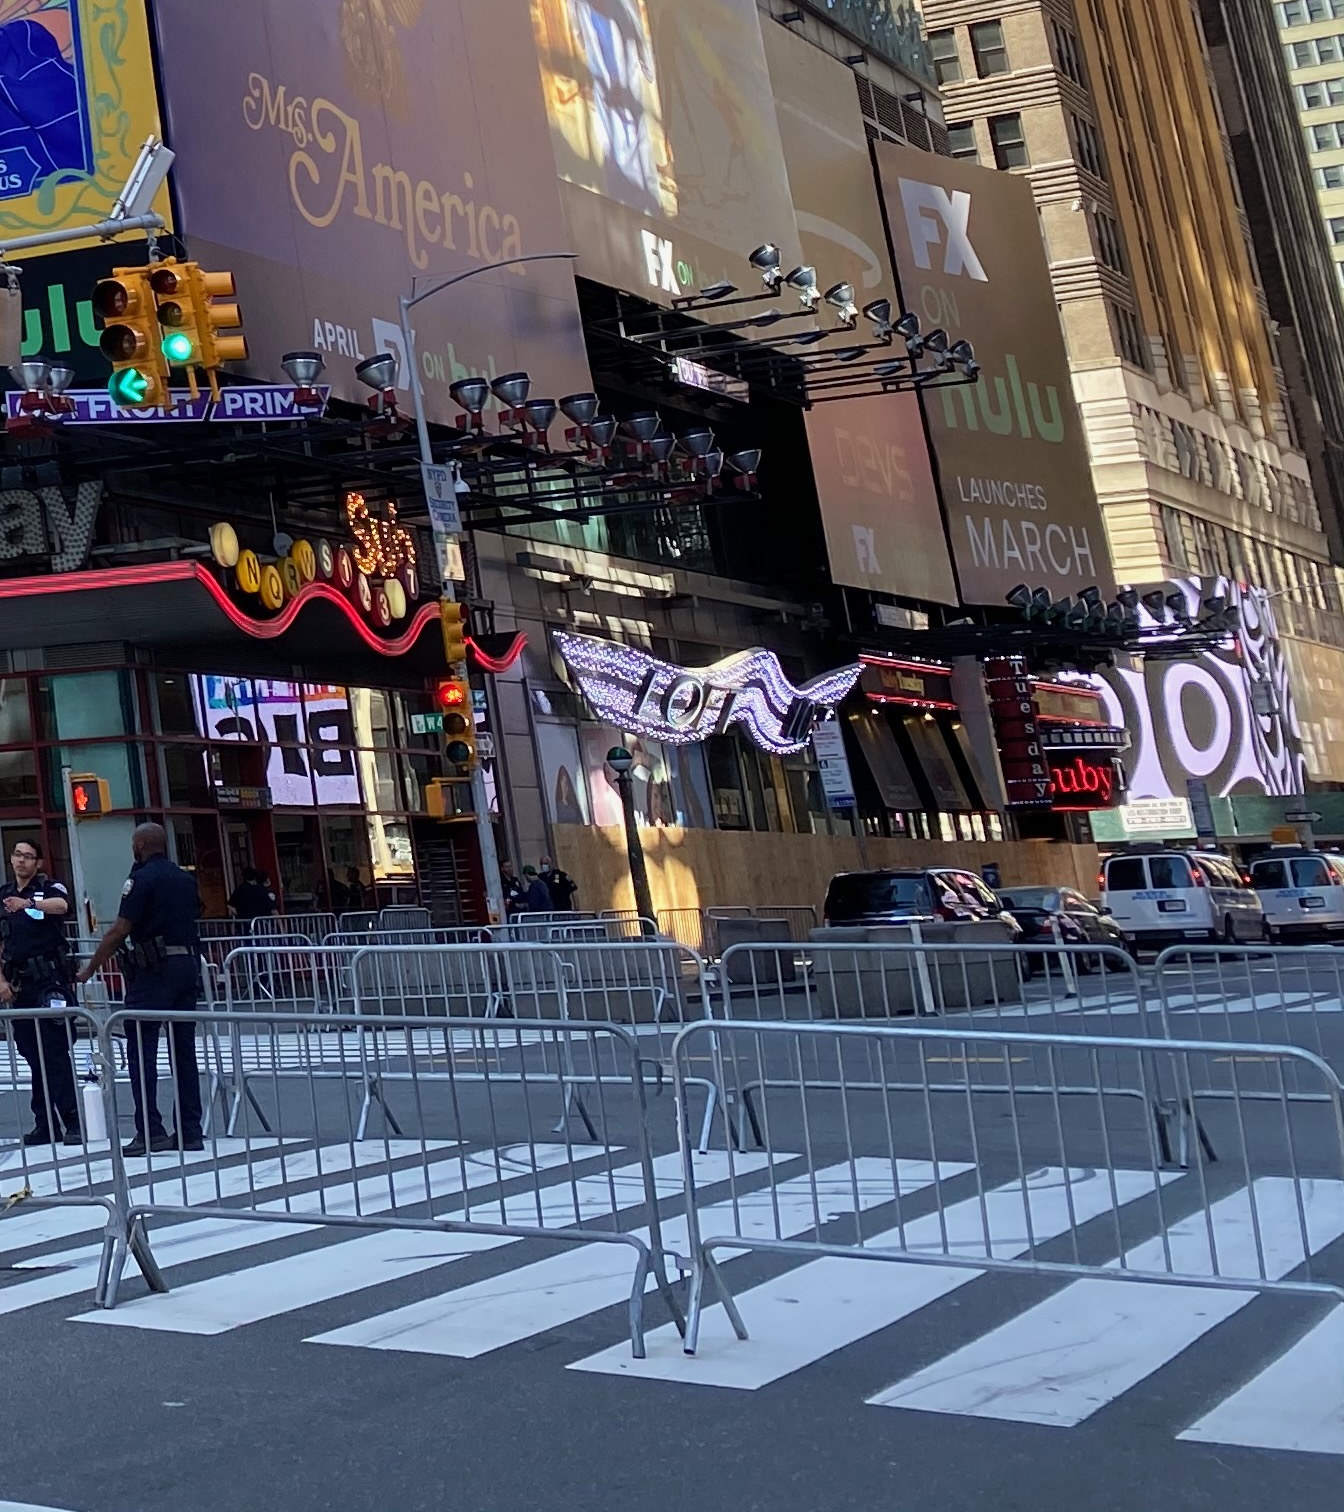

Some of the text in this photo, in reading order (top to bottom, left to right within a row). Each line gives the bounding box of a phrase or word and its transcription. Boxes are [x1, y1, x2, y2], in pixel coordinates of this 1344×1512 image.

[243, 73, 525, 276] Mrs. America
[897, 176, 989, 282] FX
[641, 229, 681, 295] FX
[921, 285, 960, 328] ON
[313, 319, 365, 362] APRIL
[957, 475, 1047, 511] LAUNCHES
[851, 524, 881, 575] FX
[965, 515, 1097, 577] MARCH
[426, 715, 444, 730] W 4
[1010, 660, 1046, 796] Tuesday
[1050, 757, 1112, 801] uby
